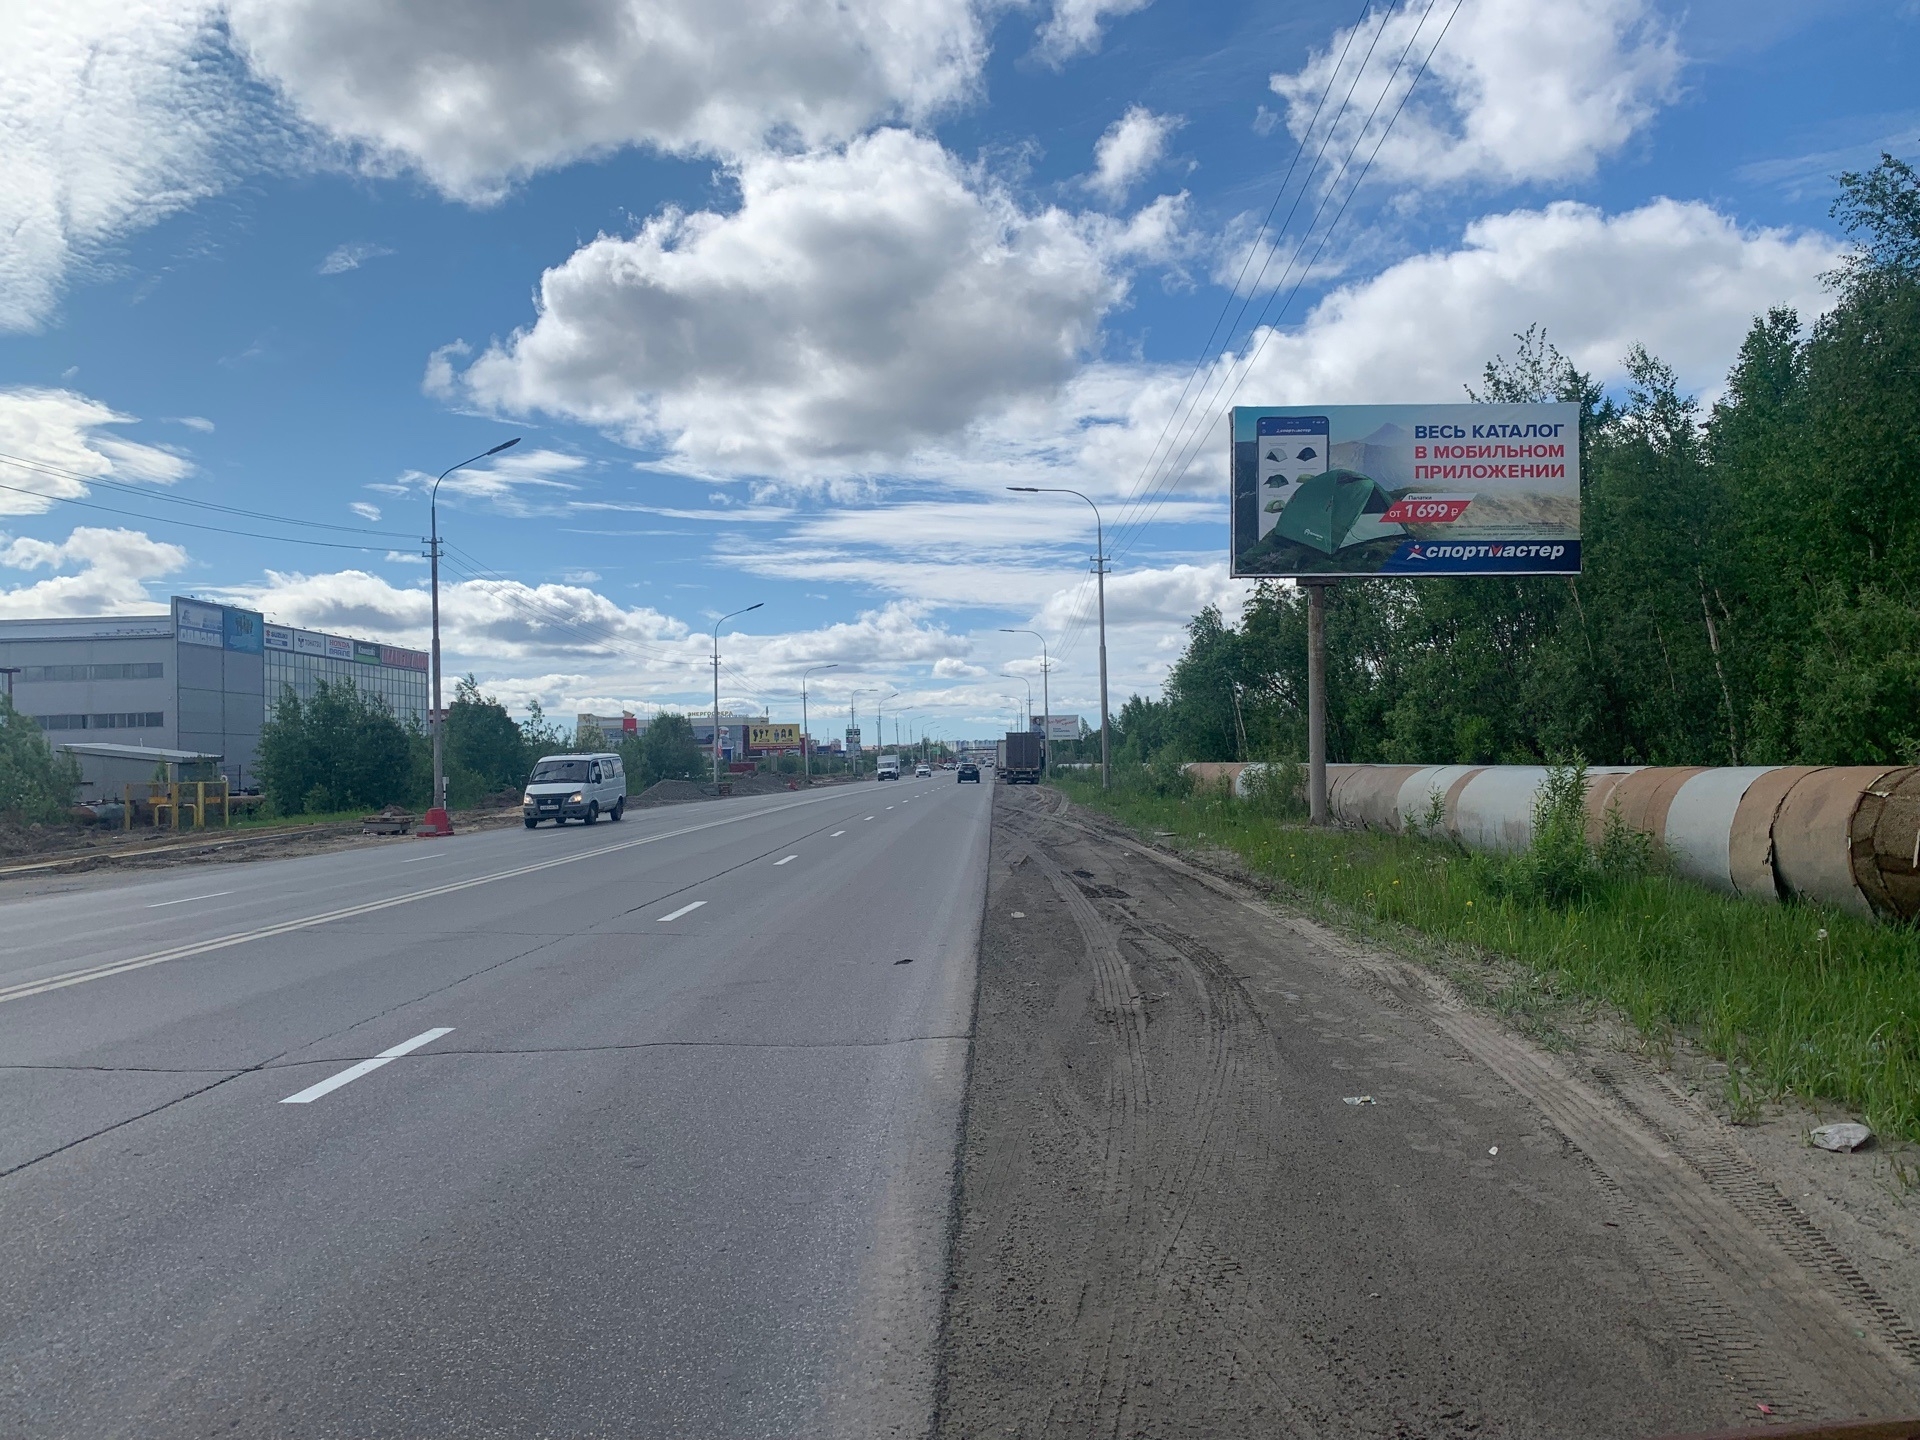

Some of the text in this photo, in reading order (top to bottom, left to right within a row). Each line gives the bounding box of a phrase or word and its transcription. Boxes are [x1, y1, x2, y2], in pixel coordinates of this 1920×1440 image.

[1414, 424, 1564, 439] ВЕСЬ КАТАЛОГ
[1415, 444, 1565, 459] В МОБИЛЬНОМ
[1414, 464, 1565, 479] ПРИЛОЖЕНИИ
[271, 631, 288, 640] SUZUKI
[305, 639, 322, 648] TOHATSU
[329, 639, 350, 649] HONDA
[329, 647, 351, 658] MARINE
